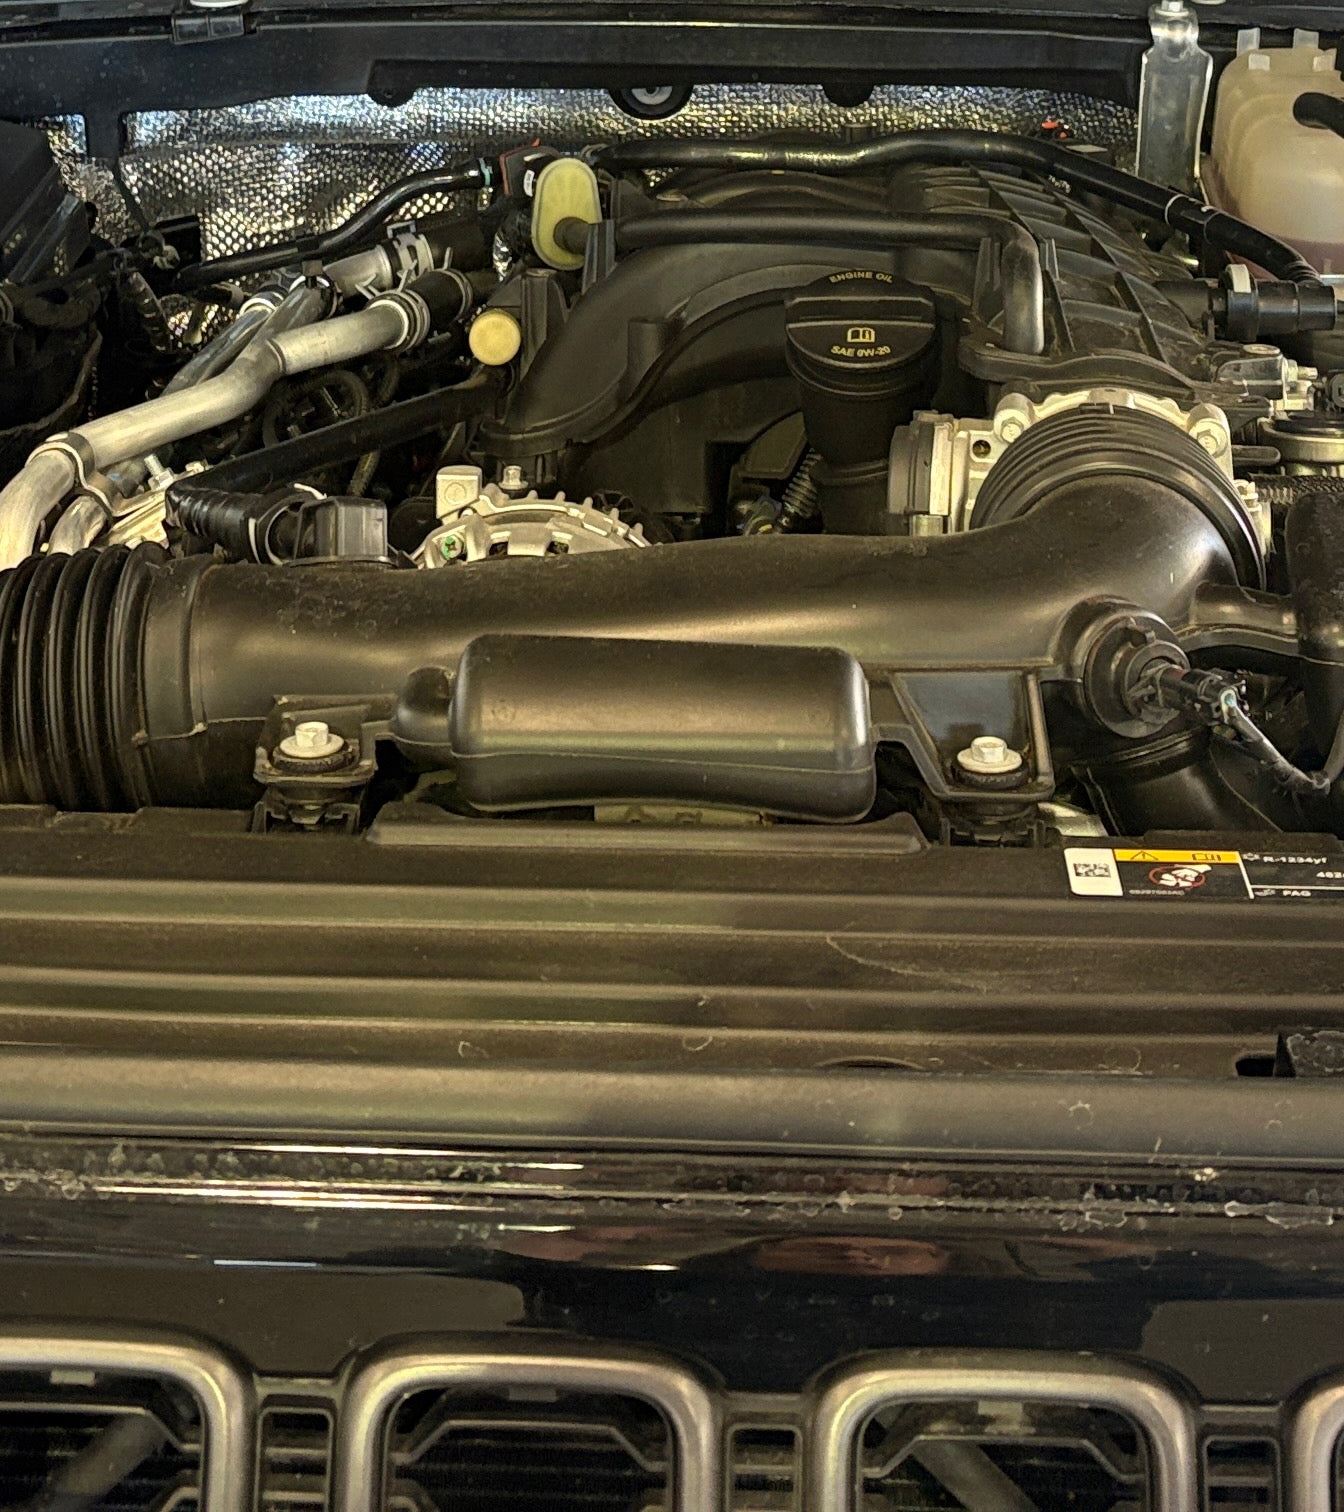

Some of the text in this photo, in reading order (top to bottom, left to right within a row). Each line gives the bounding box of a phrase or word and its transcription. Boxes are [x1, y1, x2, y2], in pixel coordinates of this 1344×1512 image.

[829, 271, 894, 284] ENGINE OIL
[831, 345, 891, 357] SAE 0W-20
[1263, 856, 1327, 865] R-1234yf
